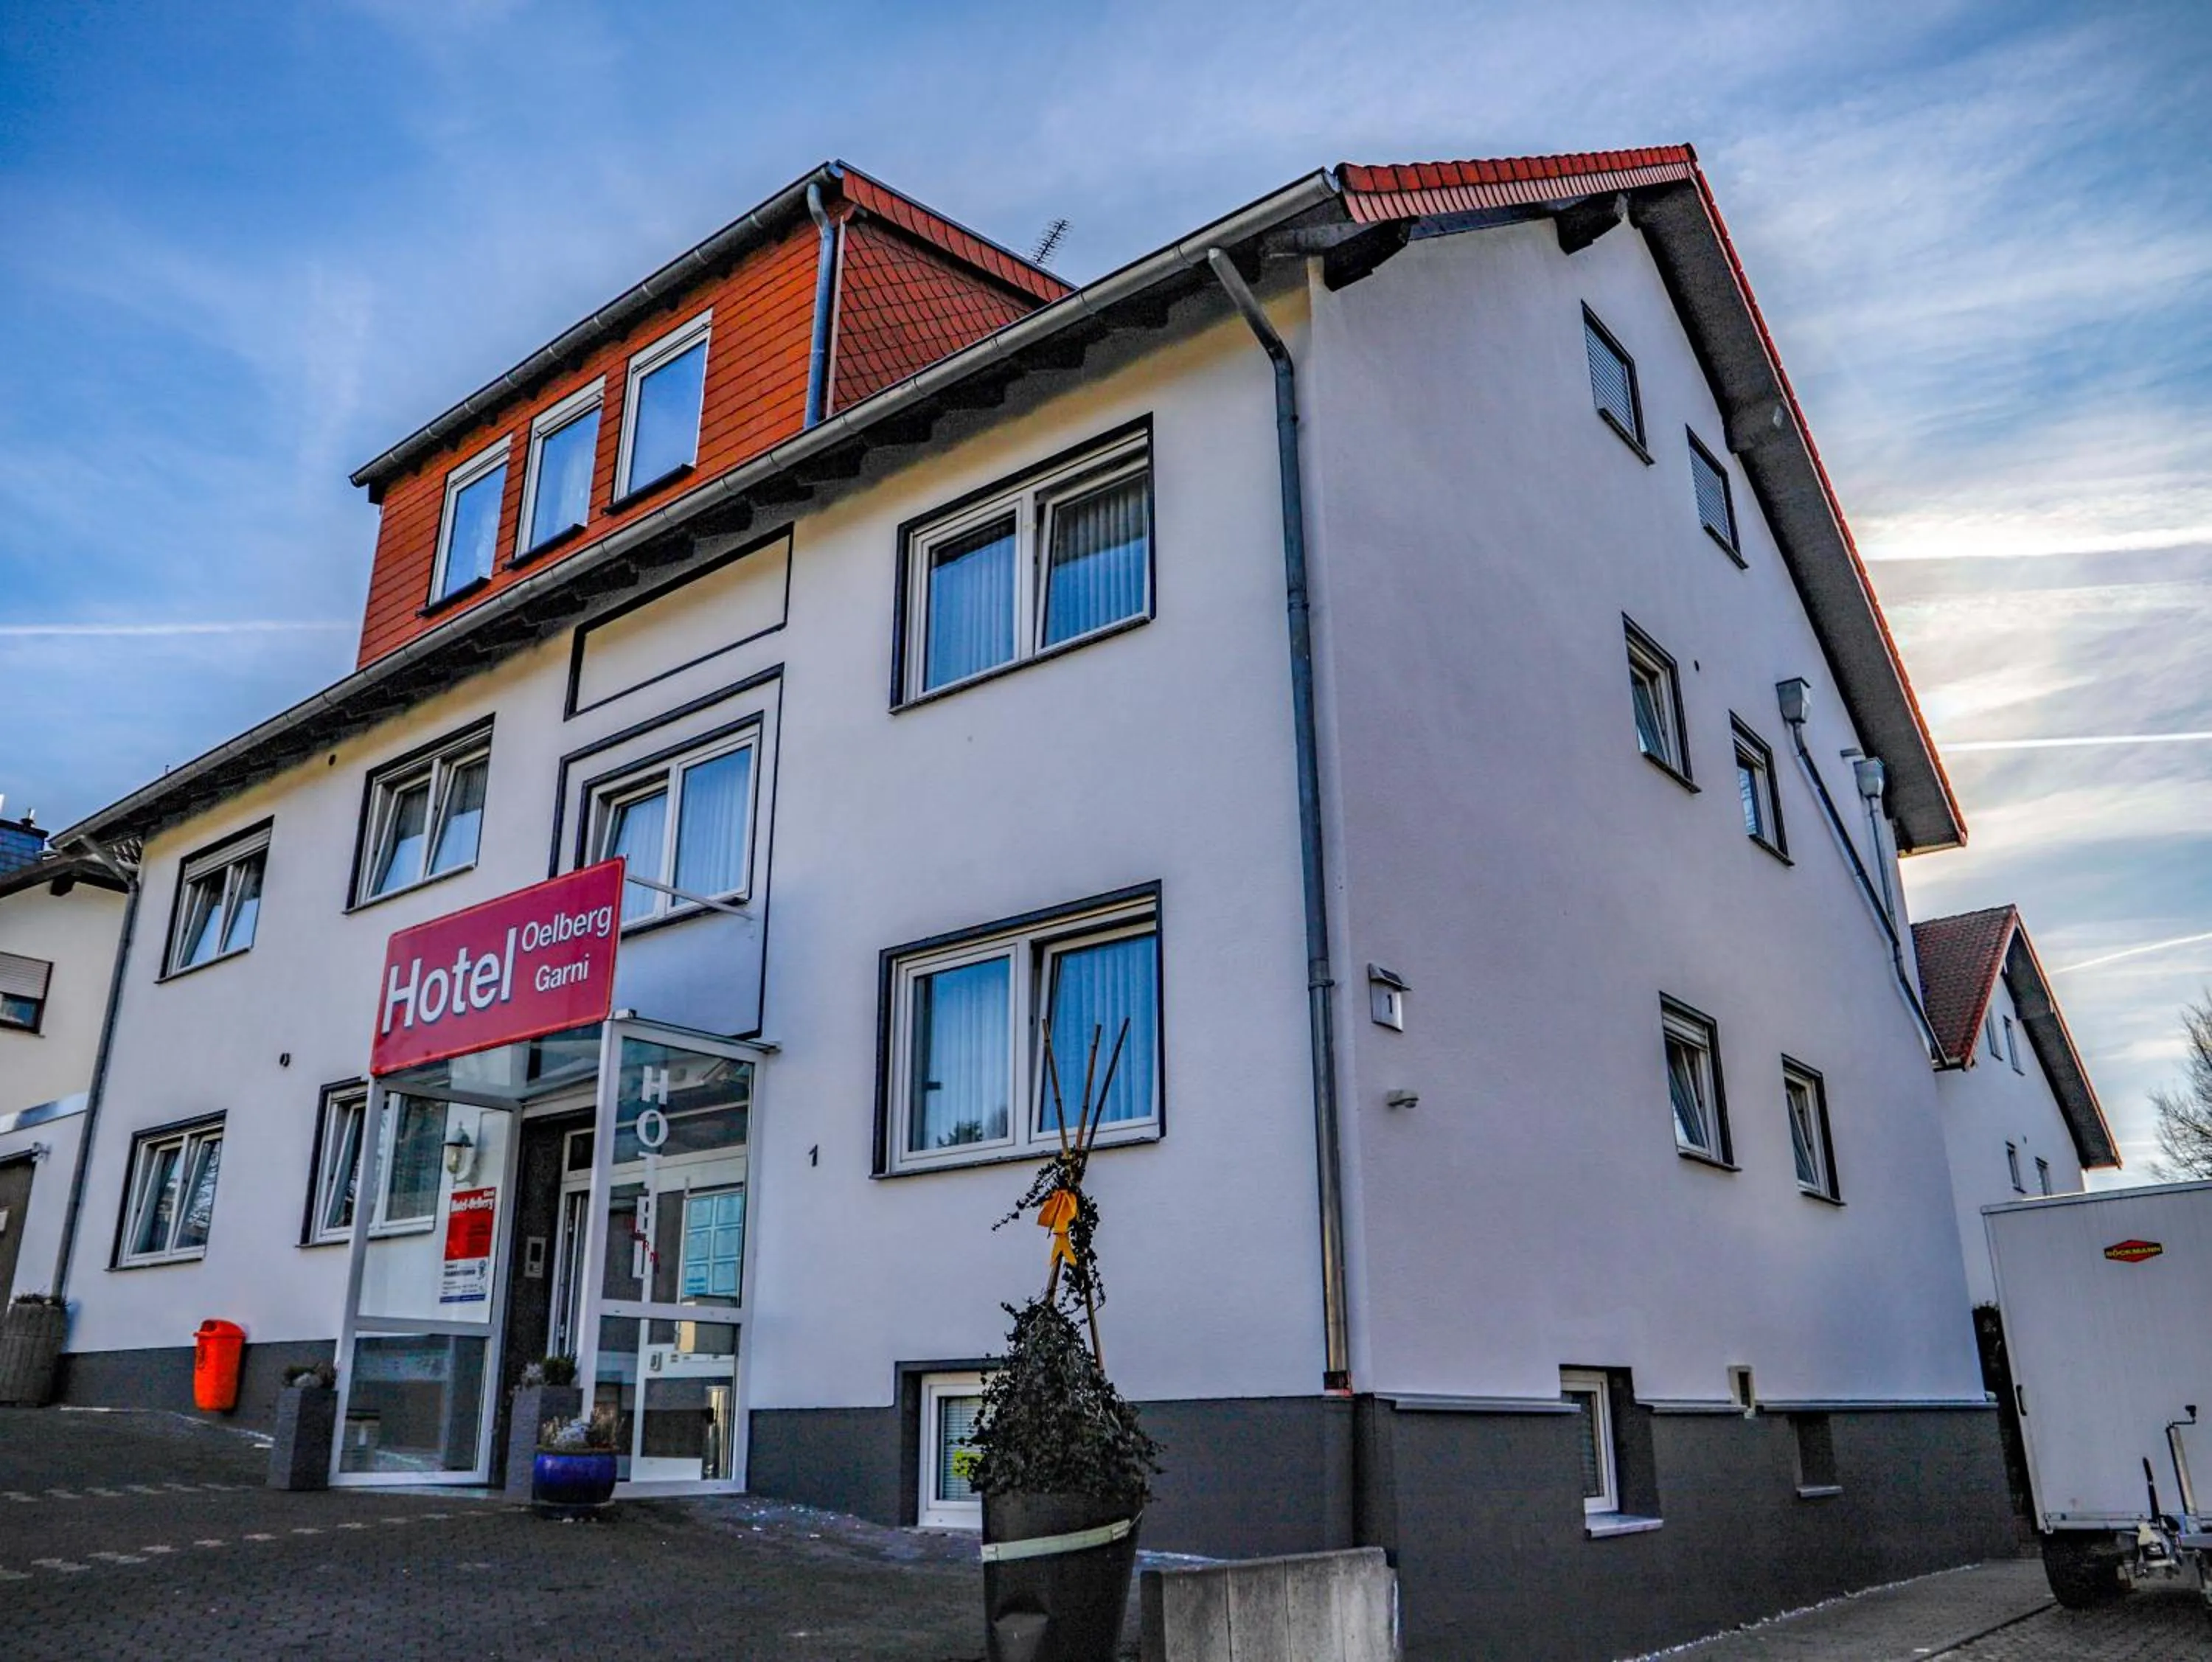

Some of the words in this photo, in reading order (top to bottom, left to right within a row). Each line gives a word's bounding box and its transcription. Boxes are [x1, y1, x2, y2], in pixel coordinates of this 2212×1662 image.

[521, 905, 613, 952] Oelberg
[381, 927, 517, 1035] Hotel
[535, 953, 590, 992] Garni
[808, 1143, 818, 1168] 1
